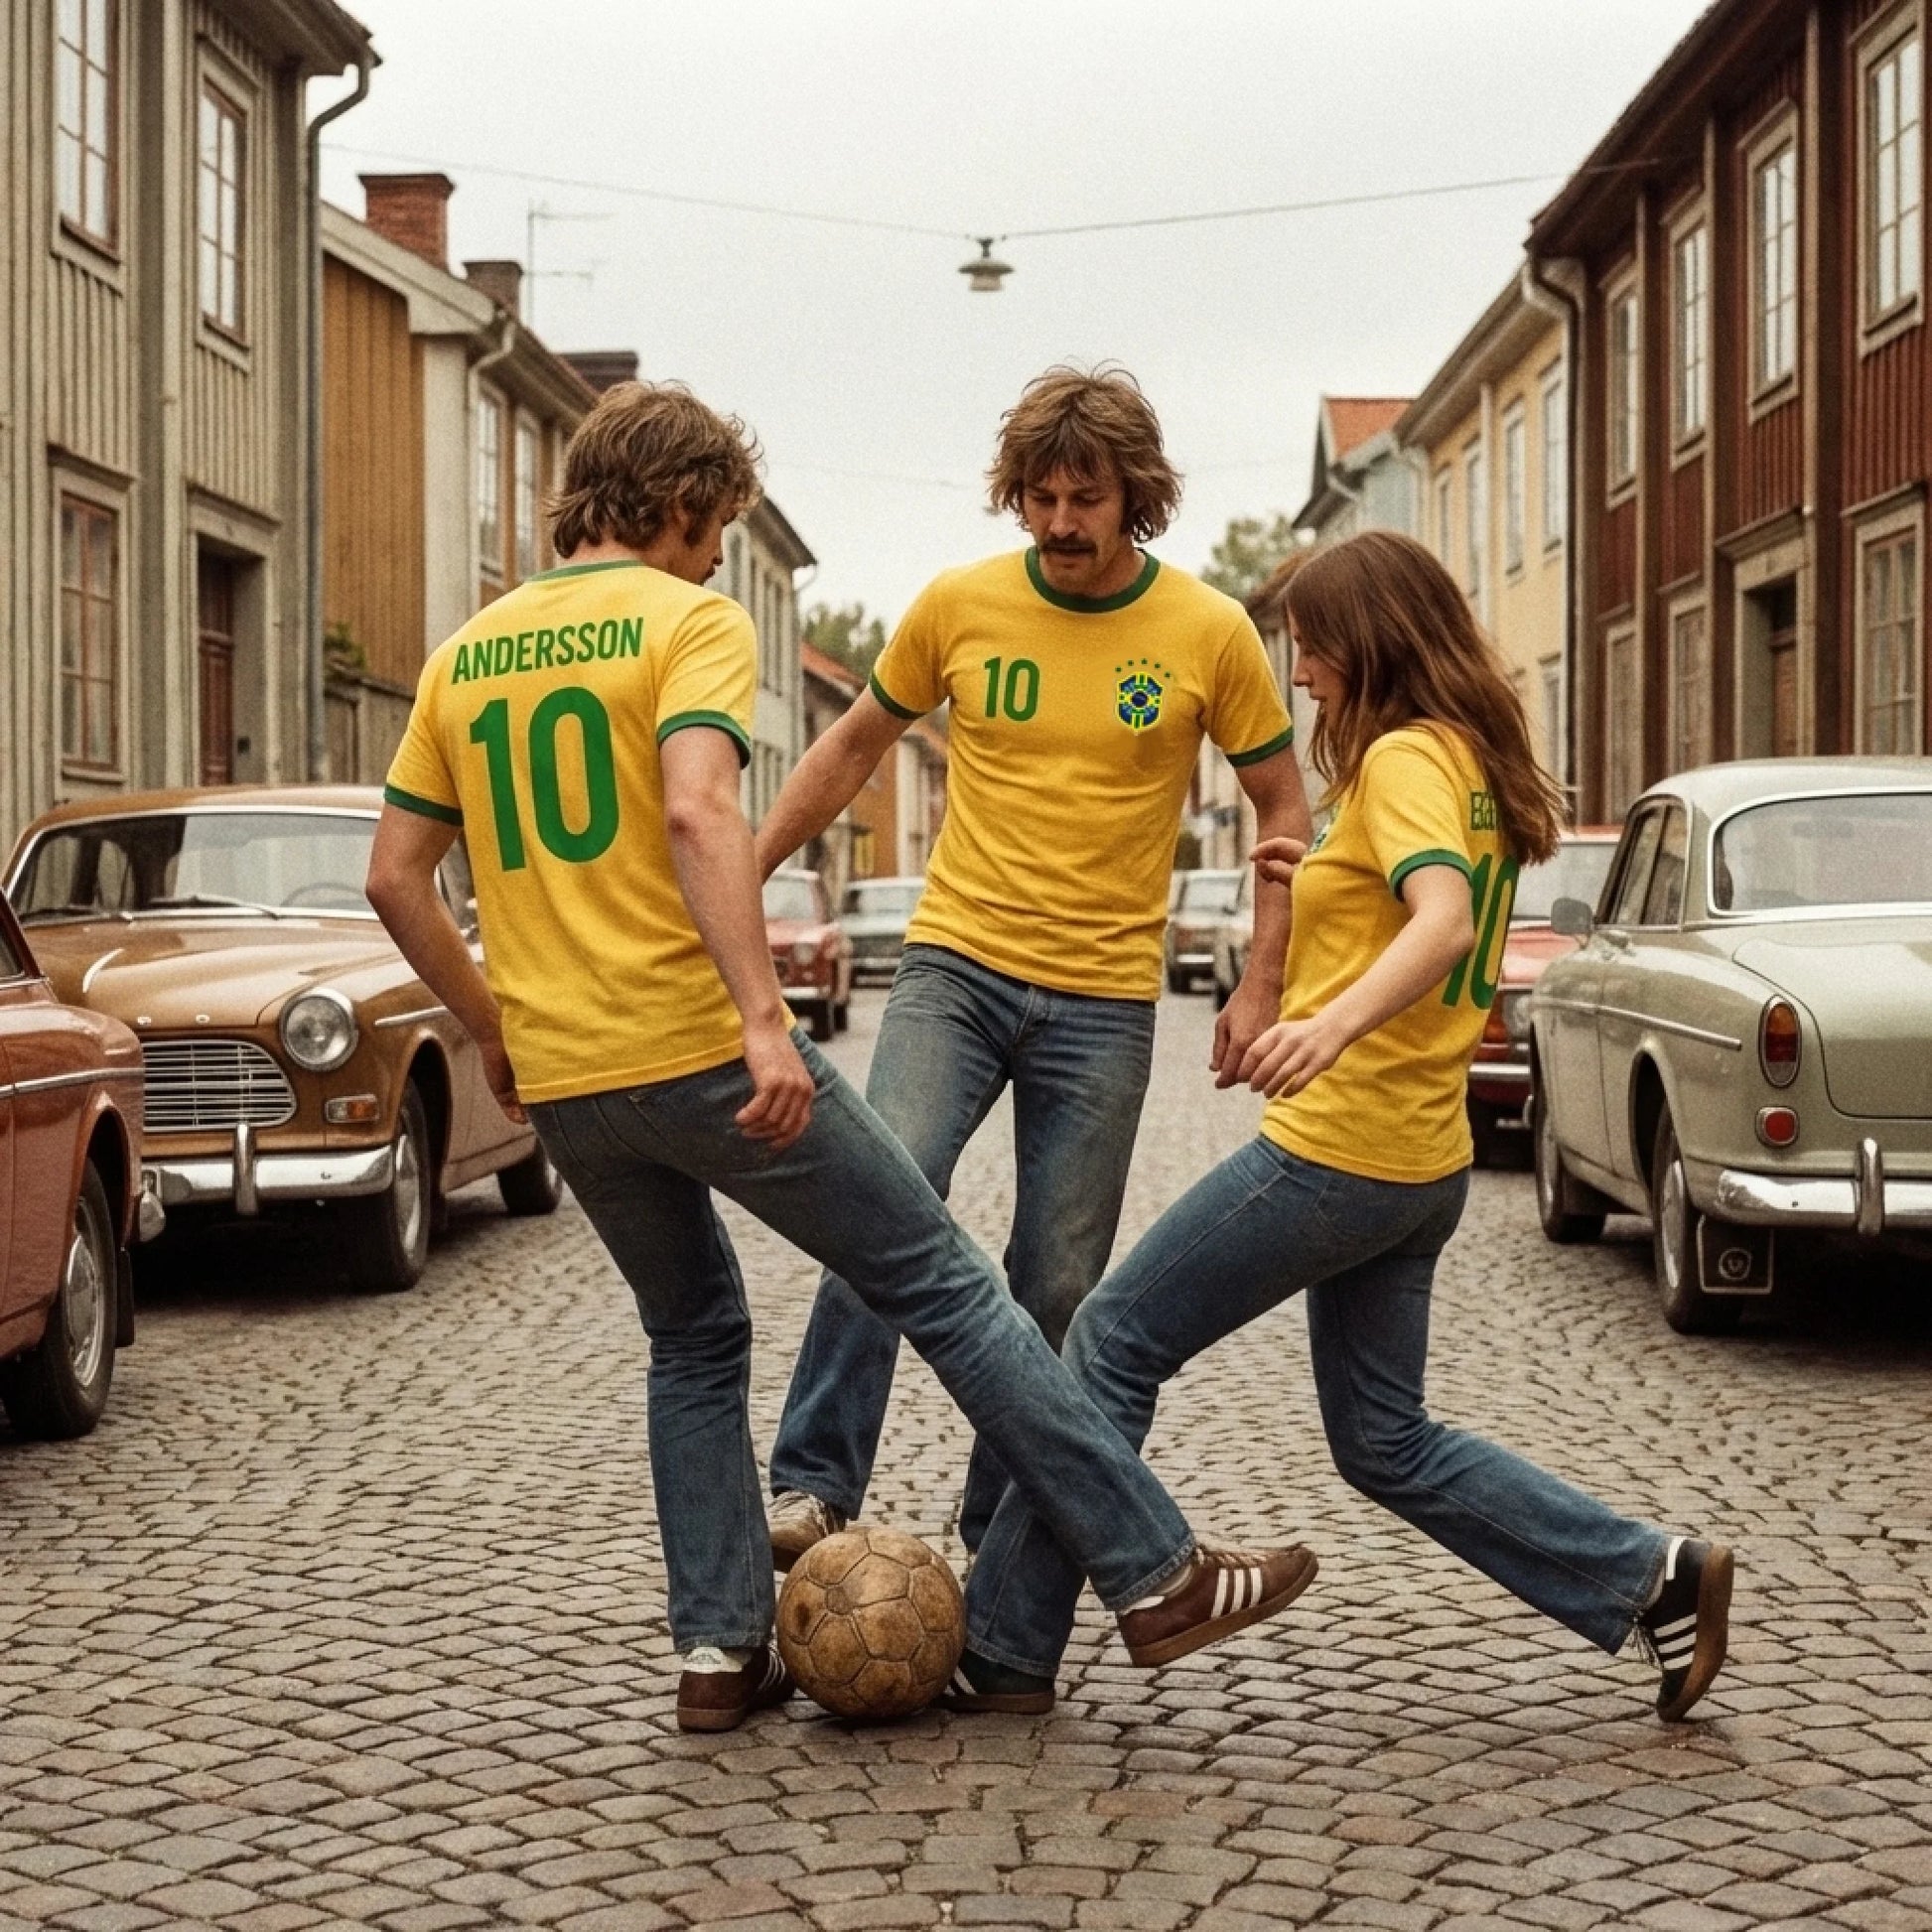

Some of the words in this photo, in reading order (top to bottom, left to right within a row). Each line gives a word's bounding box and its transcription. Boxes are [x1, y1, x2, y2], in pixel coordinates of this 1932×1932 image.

[452, 617, 643, 685] ANDERSSON
[984, 656, 1039, 722] 10
[470, 686, 620, 872] 10
[1442, 852, 1520, 1010] 10
